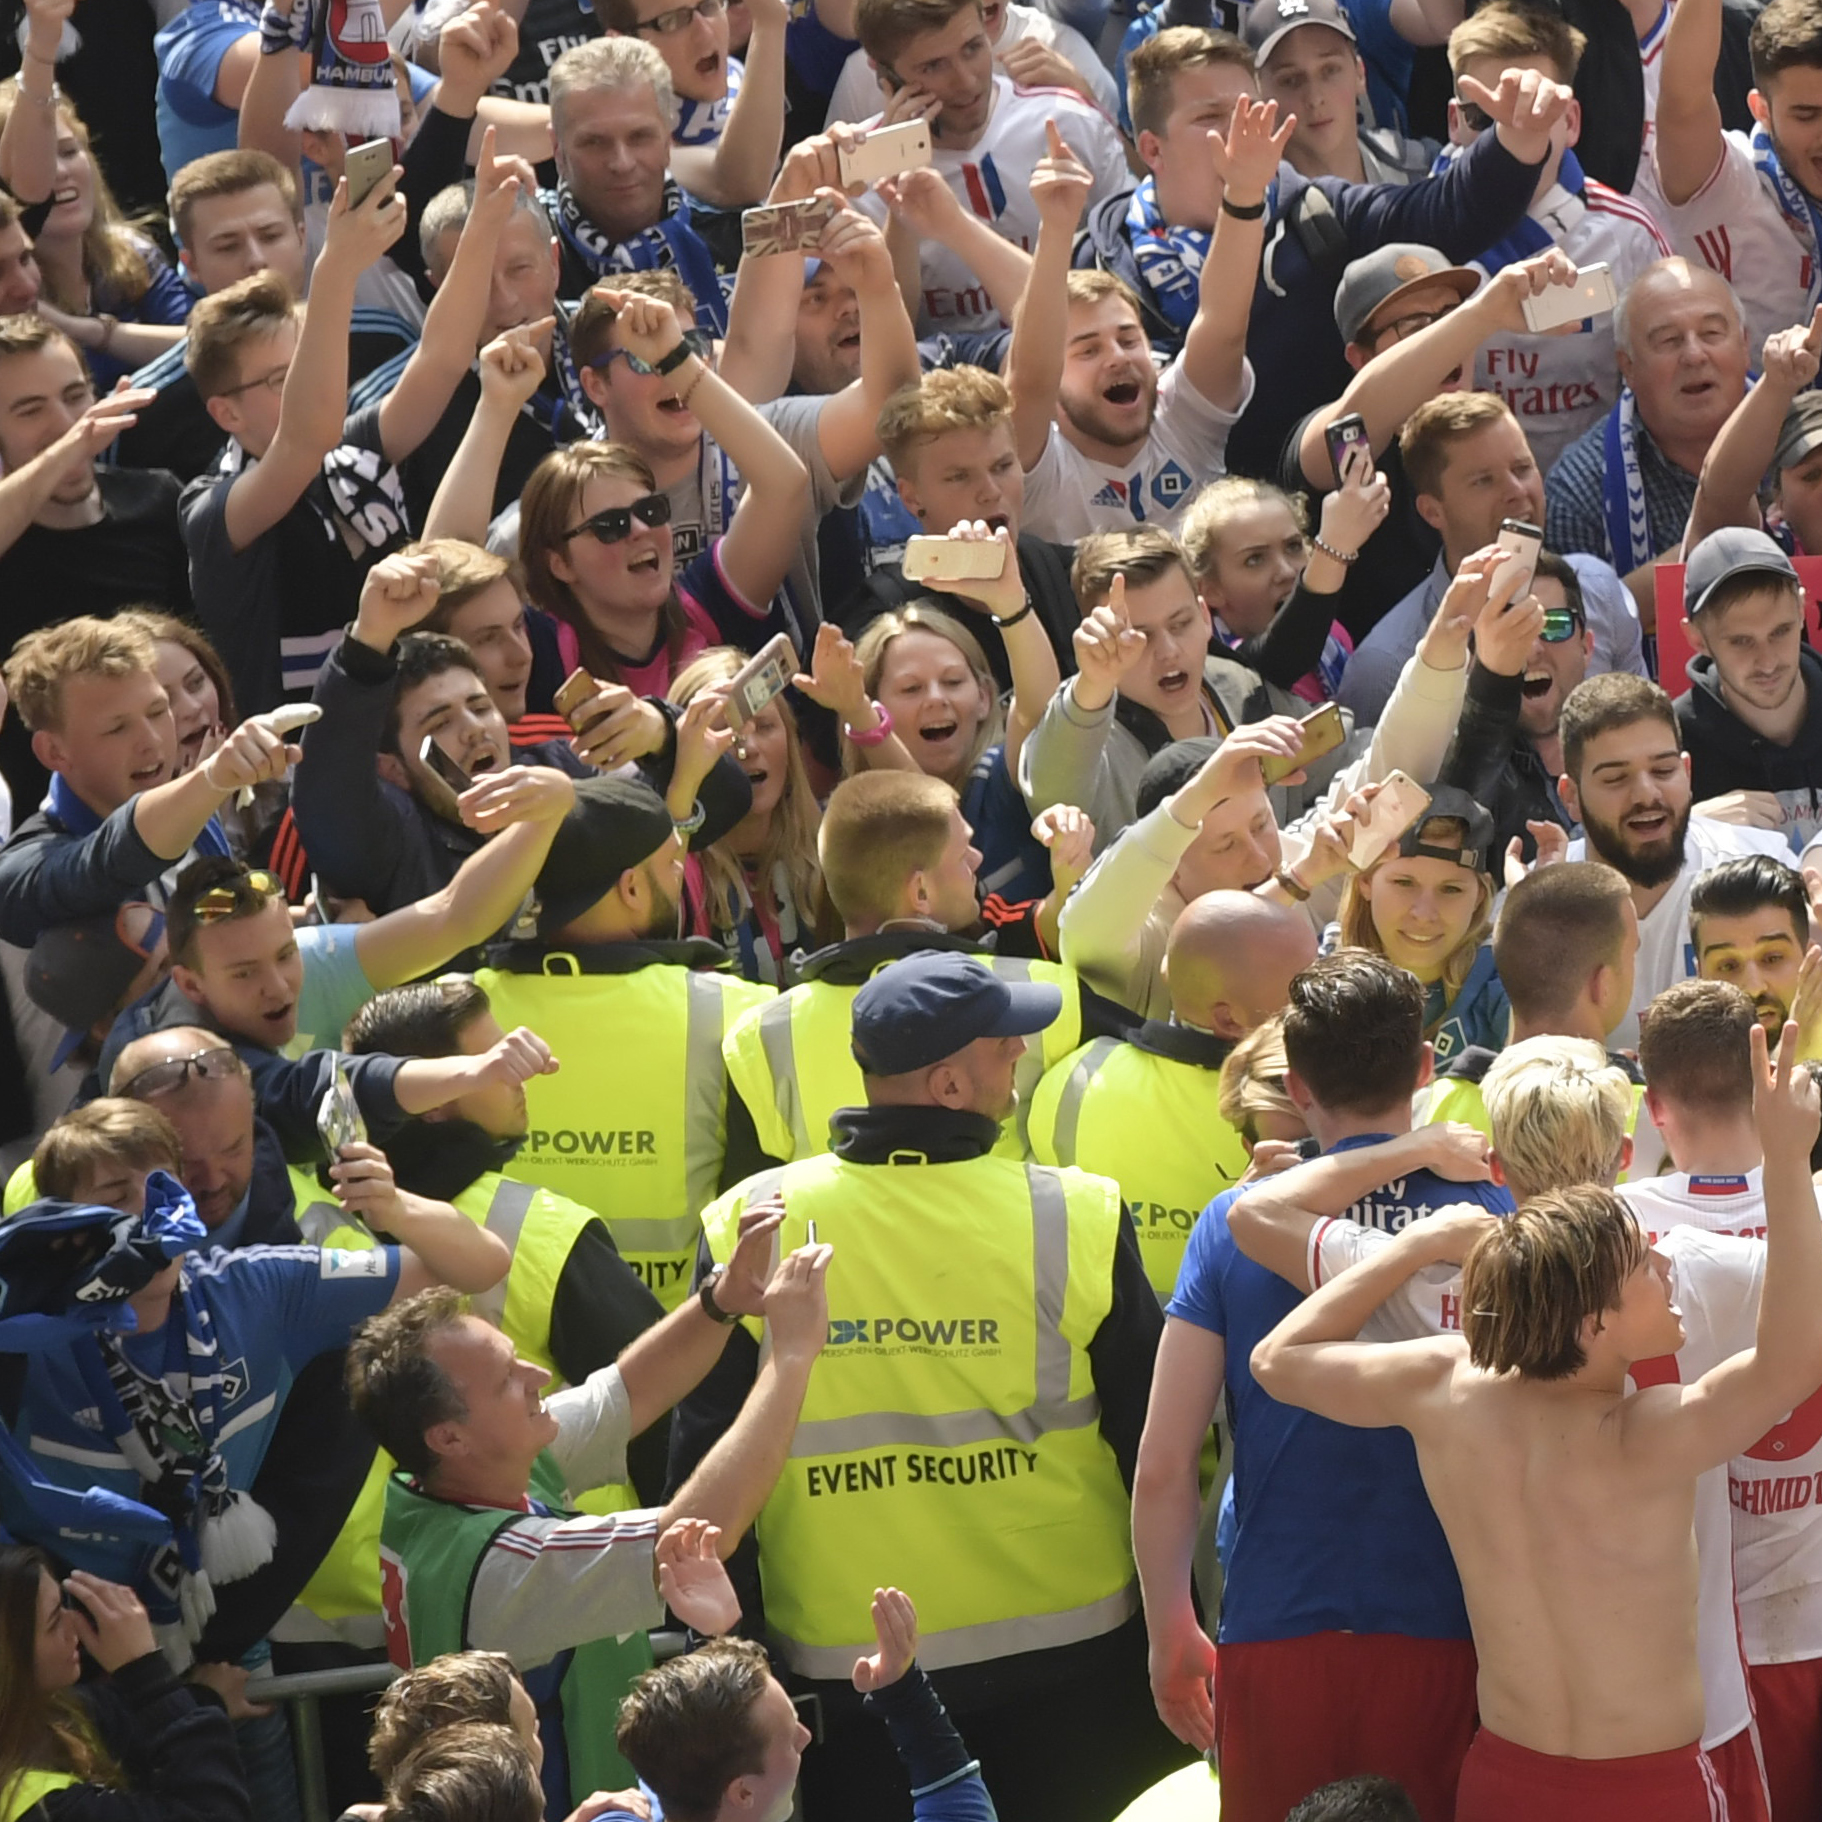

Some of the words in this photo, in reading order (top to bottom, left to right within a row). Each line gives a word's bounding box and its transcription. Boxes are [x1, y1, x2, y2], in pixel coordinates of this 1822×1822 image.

[1484, 349, 1541, 380] Fly
[1488, 377, 1602, 419] irates
[532, 1129, 657, 1156] POWER
[875, 1317, 1001, 1346] POWER
[807, 1455, 899, 1497] EVENT
[906, 1448, 1041, 1485] SECURITY
